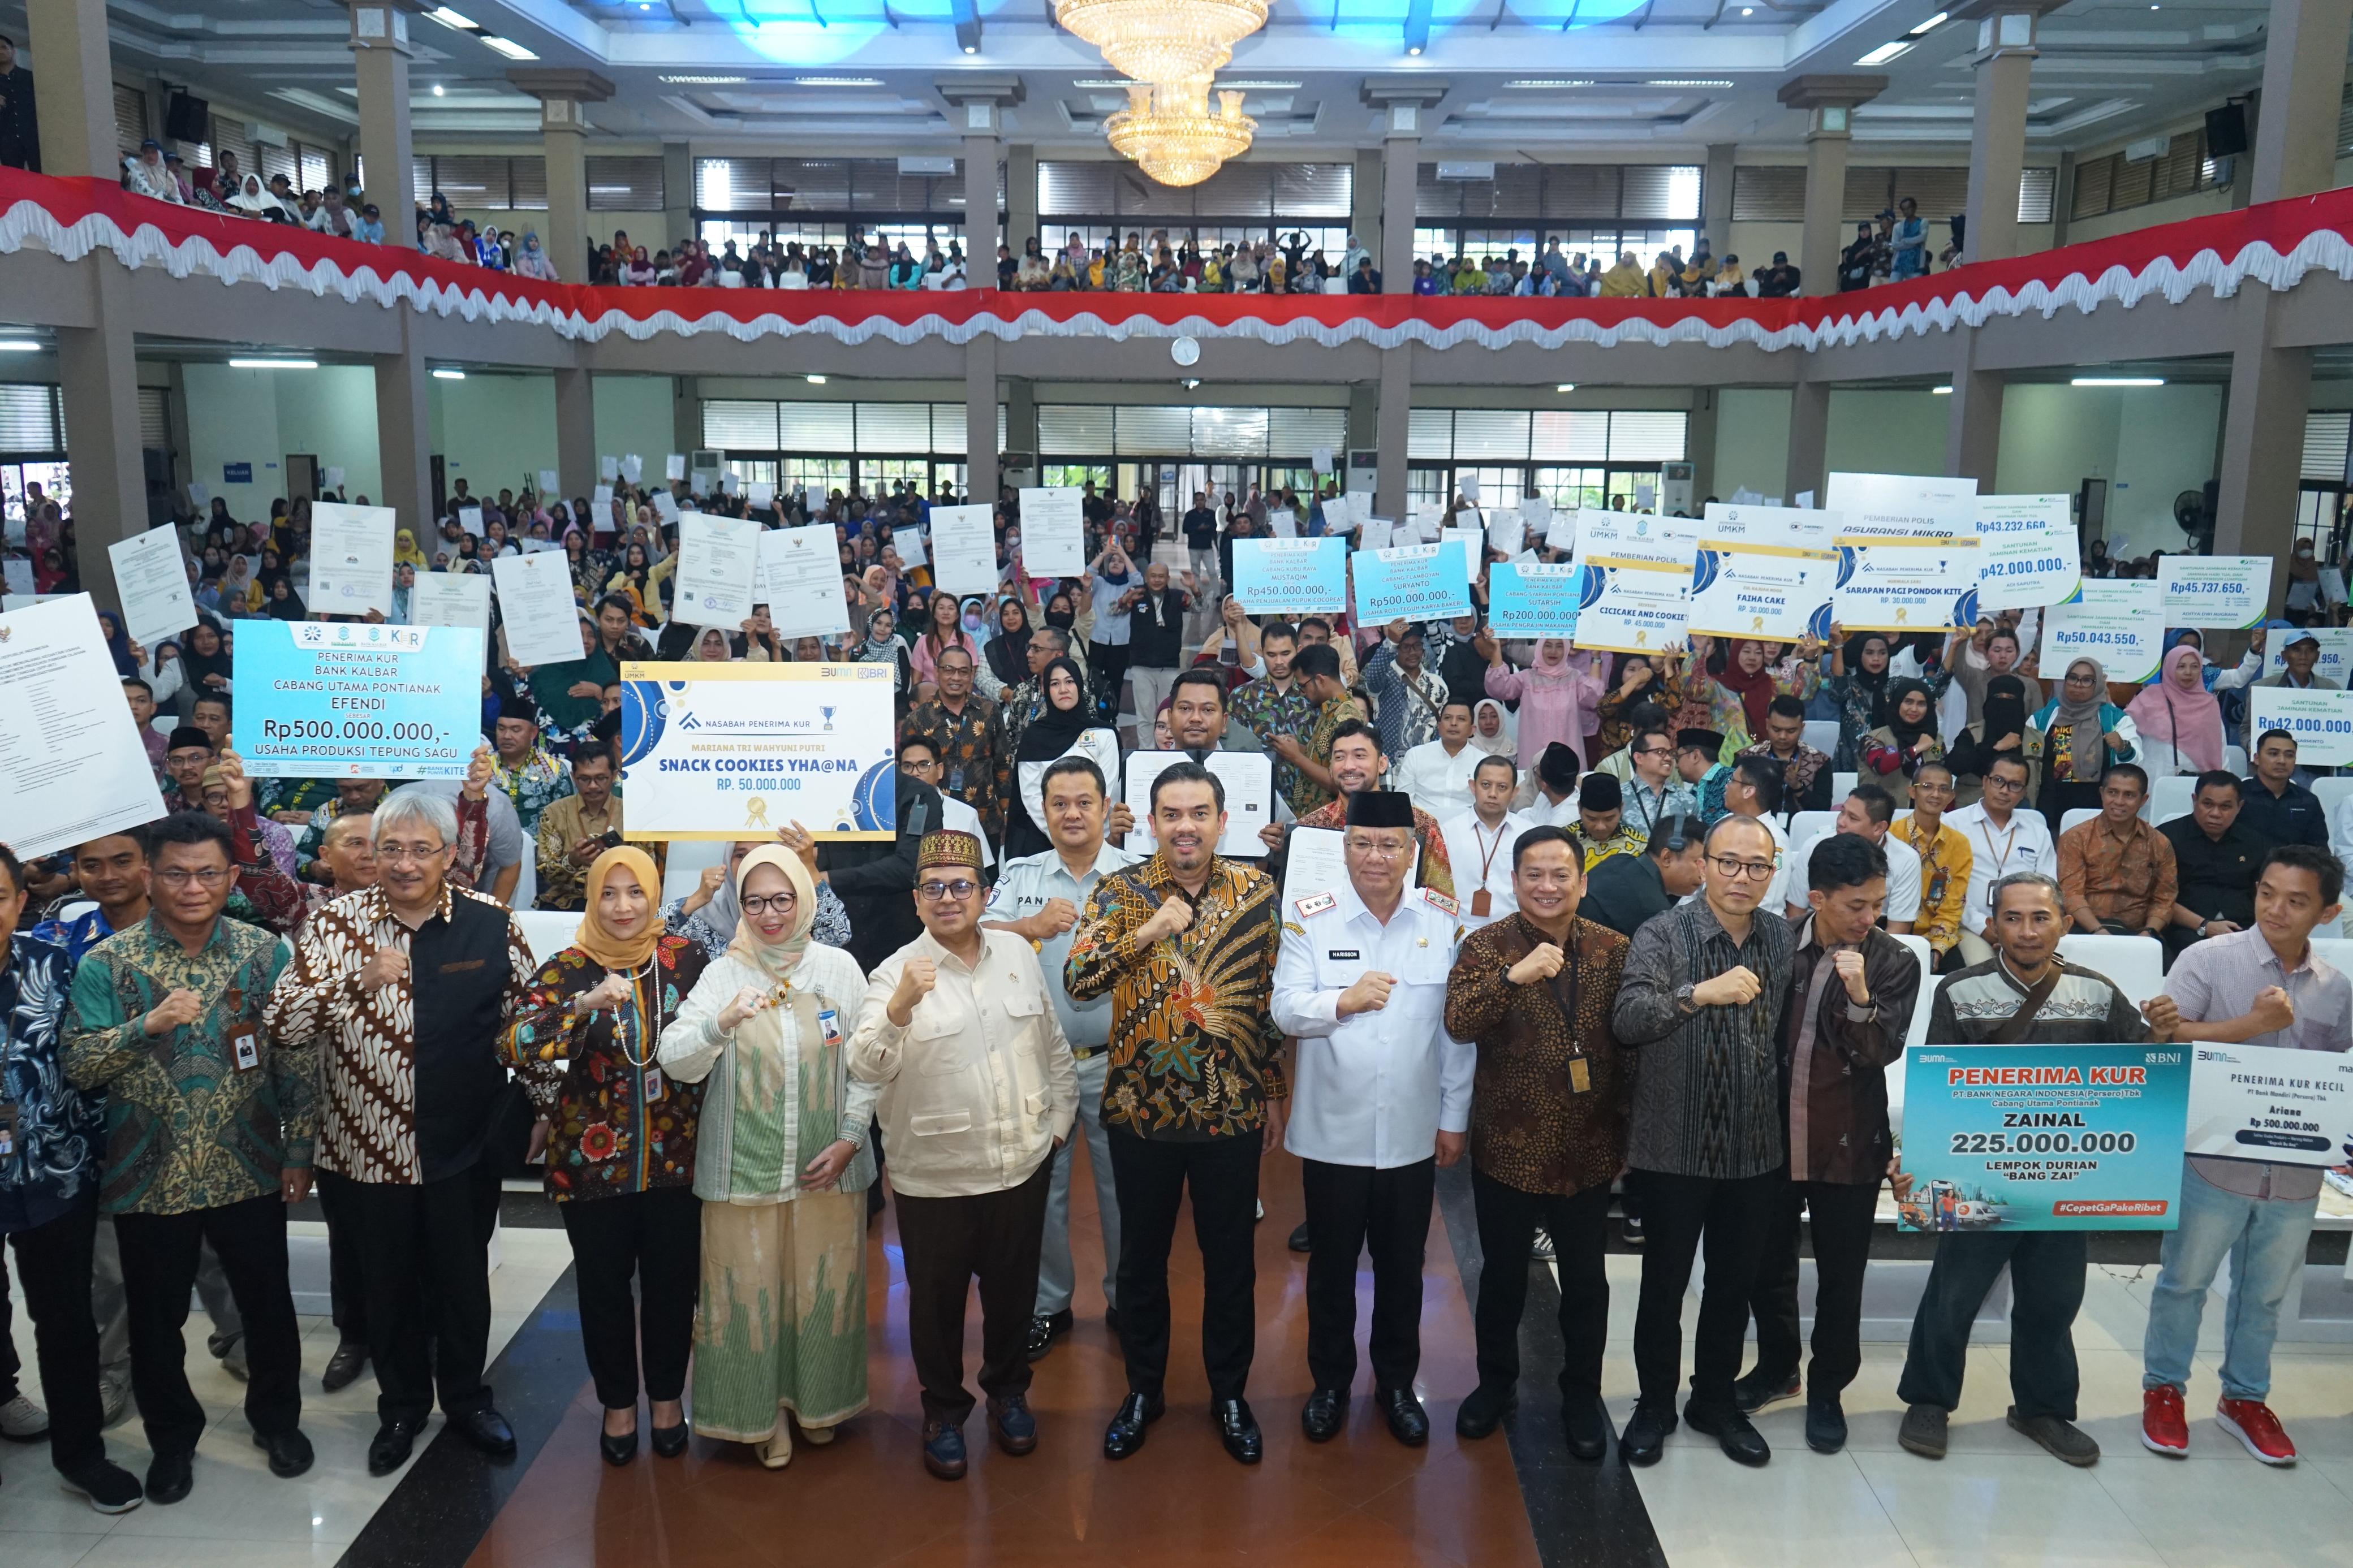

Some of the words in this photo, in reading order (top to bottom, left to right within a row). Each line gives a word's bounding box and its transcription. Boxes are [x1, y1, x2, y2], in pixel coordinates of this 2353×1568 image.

[1843, 526, 1909, 535] ASURANSI
[1976, 521, 2053, 533] Rp43.232.660-
[1591, 531, 1618, 539] UMKM
[1611, 552, 1653, 561] PEMBERIAN
[1979, 558, 2071, 580] p42.000.000,-
[1248, 585, 1331, 597] Rp450.000.000,-
[1394, 581, 1430, 590] SURYANTO
[2171, 582, 2249, 594] Rp45.737.650,-
[1371, 590, 1455, 608] Rp500.000.000,-
[1737, 594, 1762, 603] FAIHA
[1503, 611, 1578, 621] Rp200.000.000
[1600, 607, 1636, 616] CICICAKE
[1749, 606, 1782, 615] 30.000.000
[2057, 631, 2144, 646] Rp50.043.550,-
[318, 653, 373, 663] PENERIMA
[377, 654, 398, 663] KUR
[315, 666, 347, 676] BANK
[352, 667, 398, 677] KALBAR
[870, 668, 886, 678] BRI
[274, 680, 323, 690] CABANG
[329, 682, 369, 692] UTAMA
[373, 683, 440, 693] PONTIANAK
[332, 698, 385, 710] EFENDI
[265, 719, 449, 744] Rp500.000.000,-
[255, 745, 298, 755] USAHA
[303, 745, 364, 756] PRODUKSI
[370, 747, 420, 757] TEPUNG
[425, 748, 457, 758] SAGU
[660, 759, 710, 772] SNACK
[715, 759, 783, 771] COOKIES
[790, 759, 857, 772] YHA@NA
[717, 778, 734, 790] RP.
[739, 779, 800, 791] 50.000.000
[2158, 1053, 2180, 1062] BNI
[1949, 1068, 2082, 1085] PENERIMA
[2091, 1068, 2146, 1084] KUR
[2231, 1073, 2285, 1087] PENERIMA
[2290, 1079, 2310, 1088] KUR
[2316, 1081, 2345, 1092] KECIL
[2269, 1105, 2301, 1116] Ariana
[2004, 1113, 2085, 1127] ZAINAL
[2250, 1117, 2261, 1129] Rp
[2264, 1119, 2320, 1132] 500.000.000
[1951, 1133, 2135, 1153] 225.000.000
[1986, 1161, 2041, 1170] LEMPOK
[2046, 1161, 2097, 1170] DURIAN
[2060, 1203, 2161, 1212] #CepetGaPakeRibet
